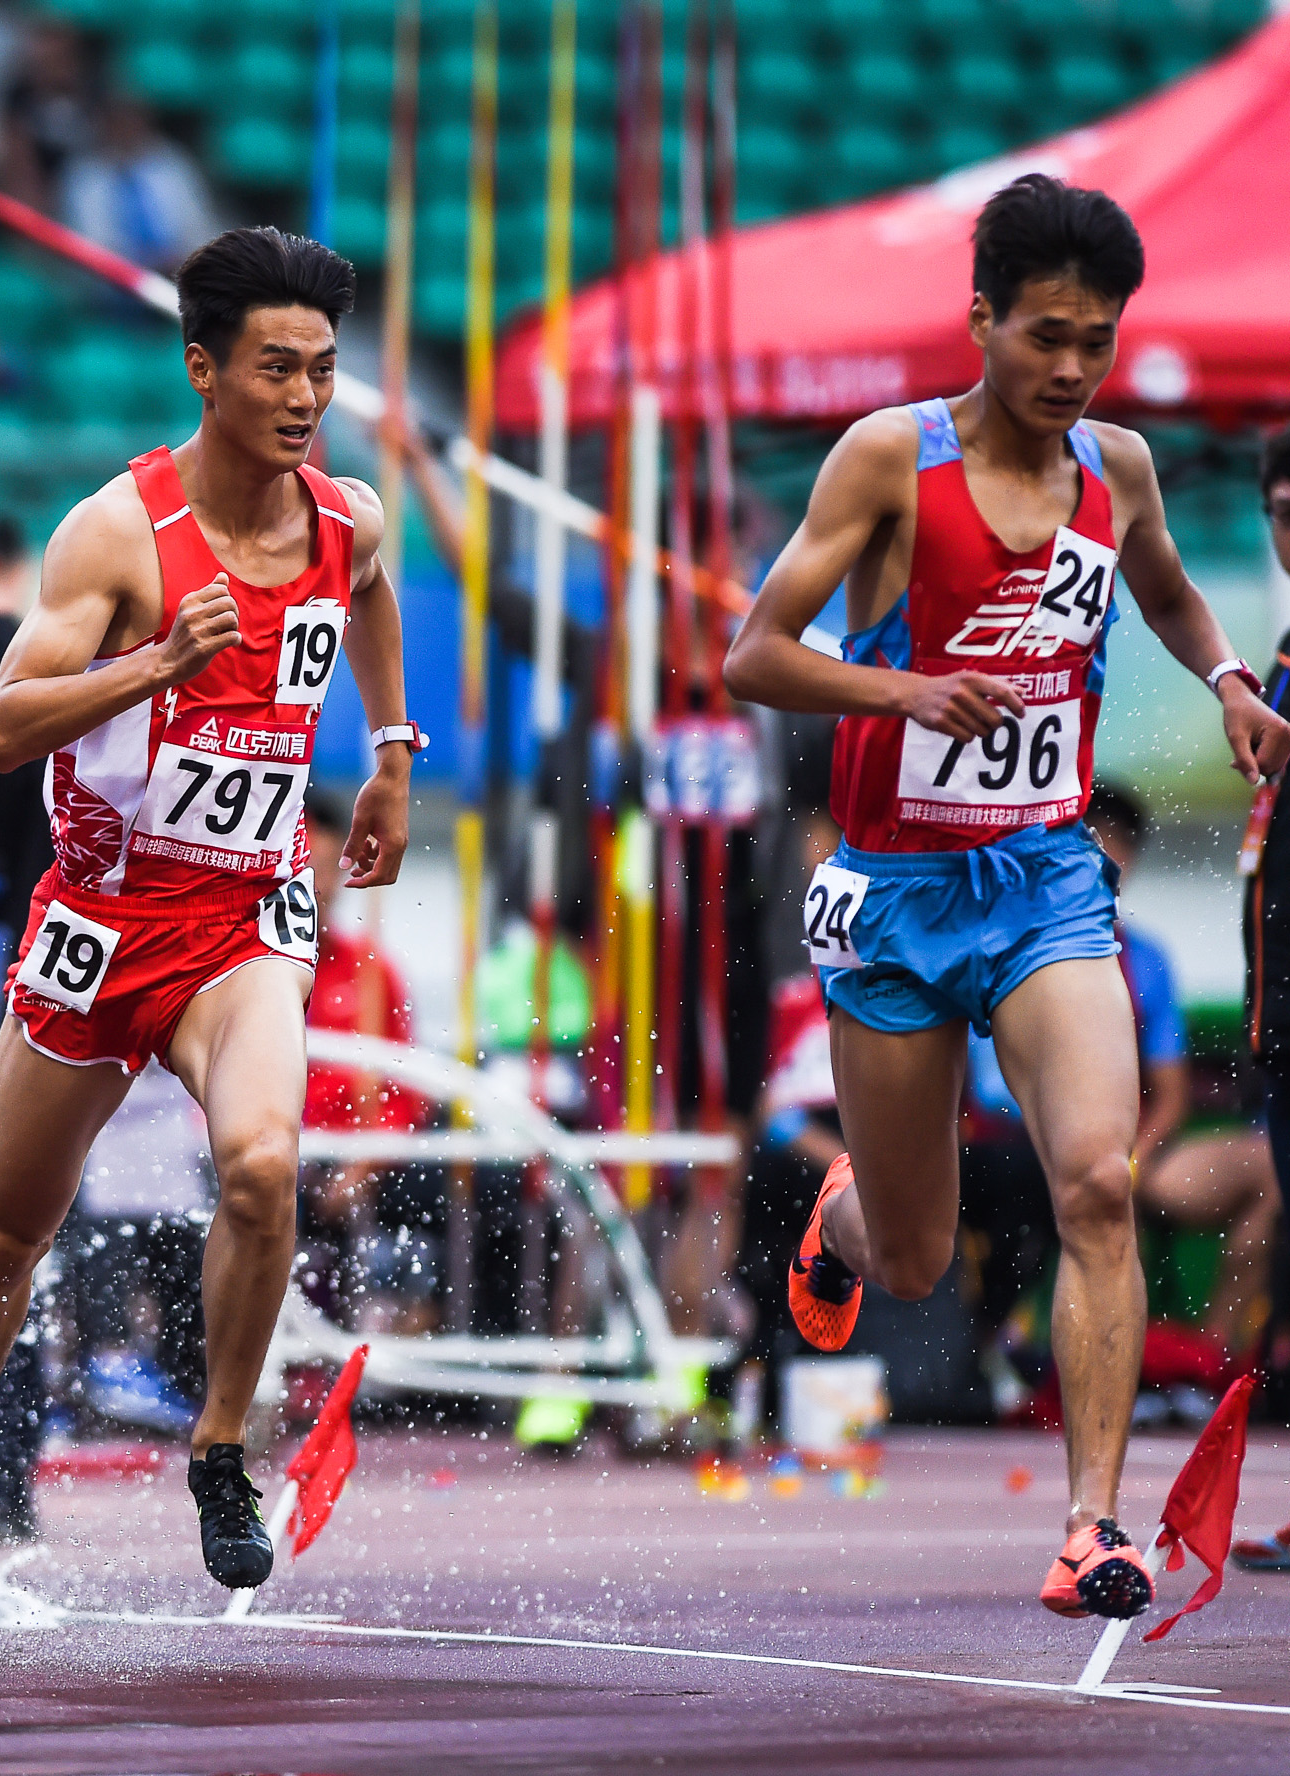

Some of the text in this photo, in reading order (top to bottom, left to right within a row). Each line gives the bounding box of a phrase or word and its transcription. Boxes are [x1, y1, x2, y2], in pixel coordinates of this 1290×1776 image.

[1040, 548, 1106, 627] 24
[286, 622, 337, 688] 19
[188, 725, 308, 759] PEAK 匹克体育
[163, 757, 295, 842] 797
[262, 880, 316, 946] 19
[808, 884, 853, 952] 24
[38, 920, 104, 994] 19
